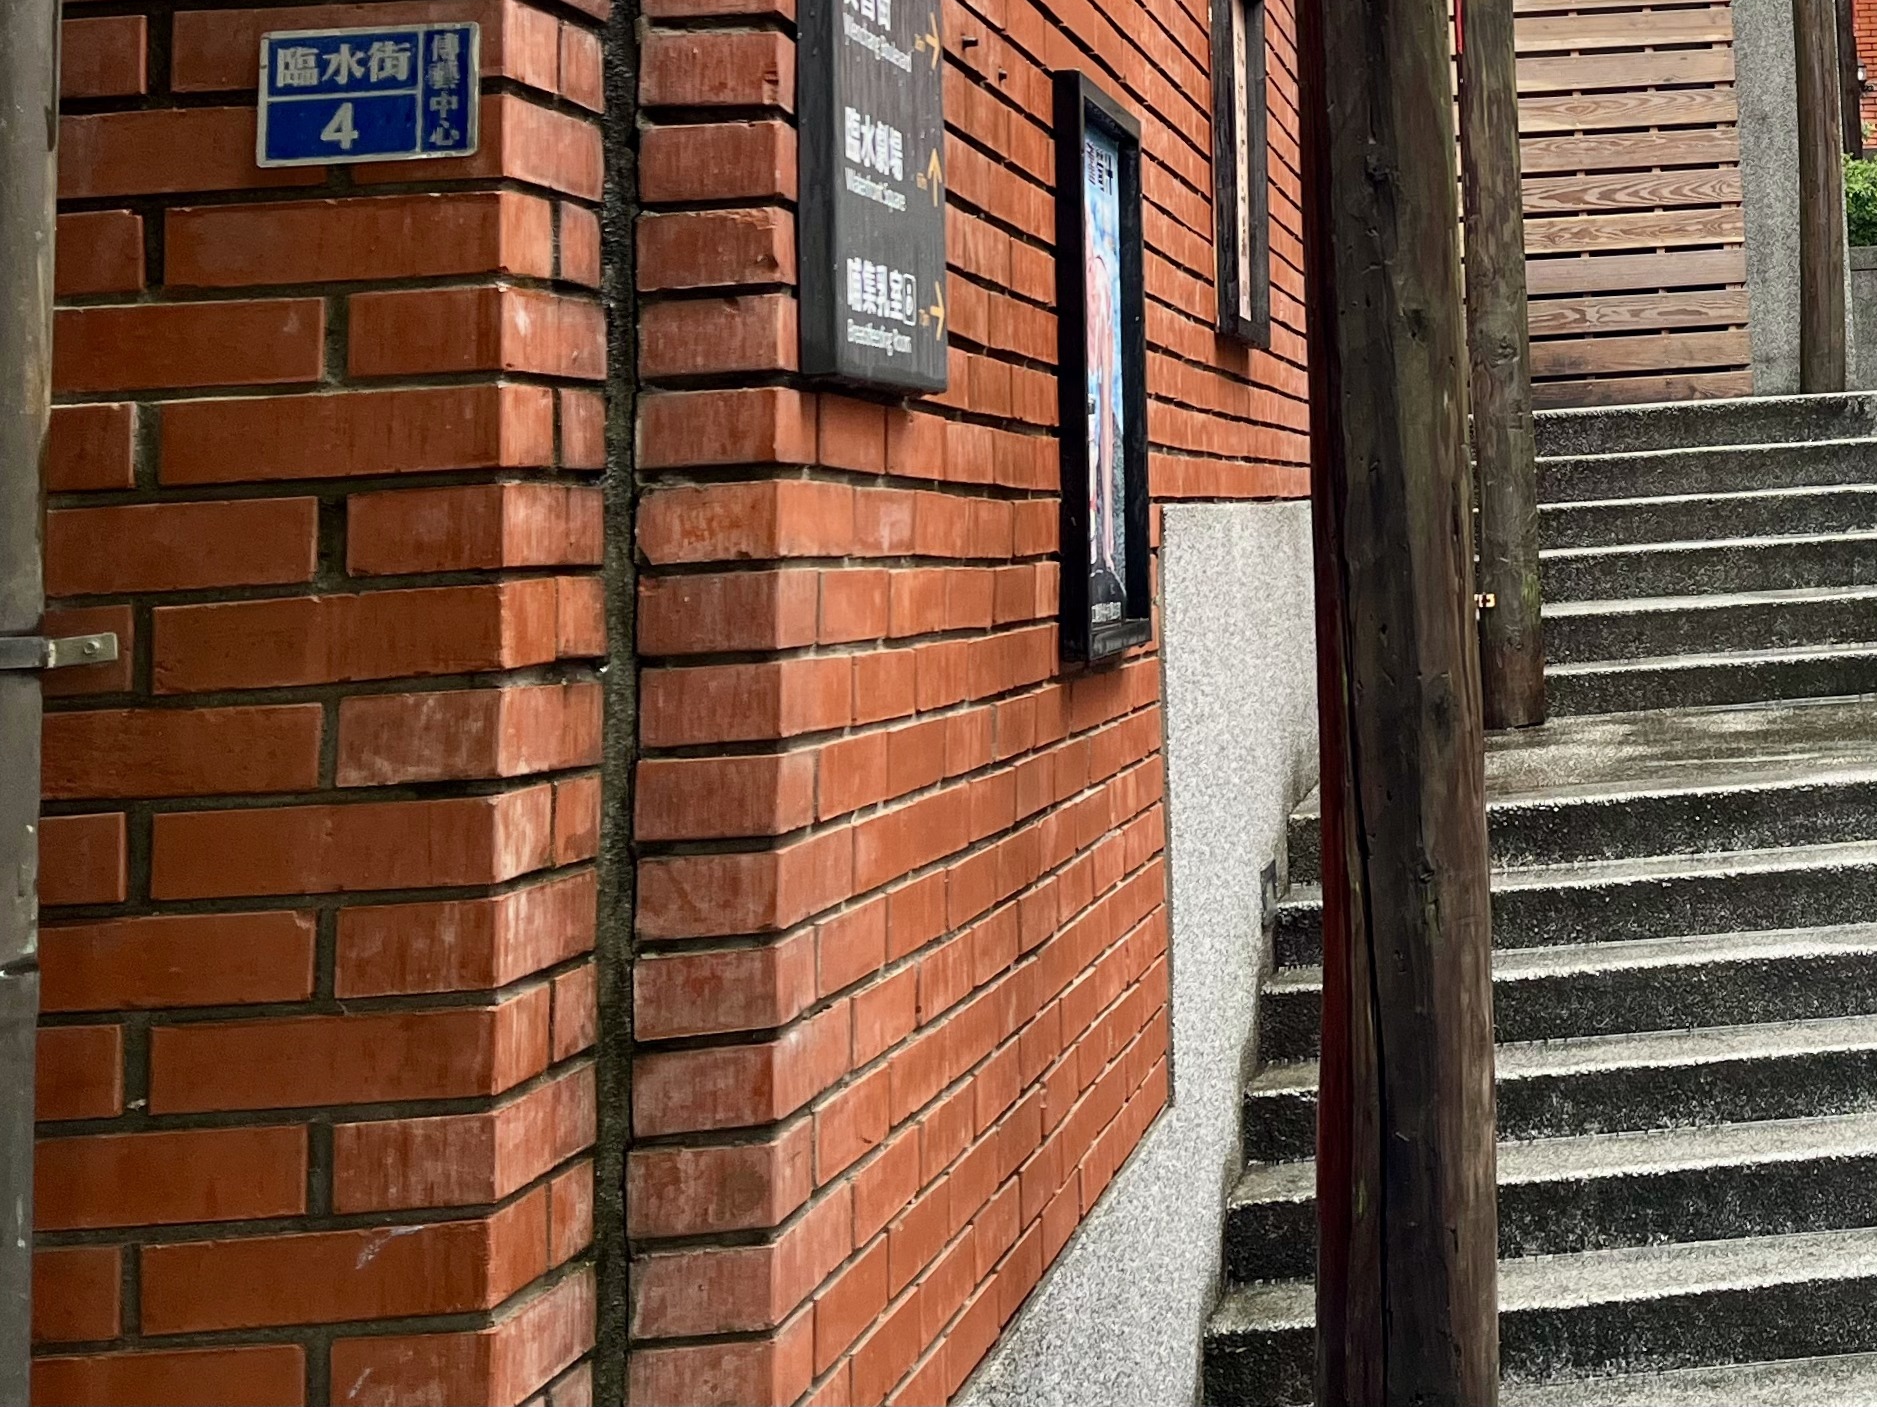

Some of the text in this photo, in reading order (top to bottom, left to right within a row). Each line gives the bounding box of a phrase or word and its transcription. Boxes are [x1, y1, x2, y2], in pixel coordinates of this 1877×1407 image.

[276, 40, 411, 88] 臨水街
[320, 102, 359, 150] 4
